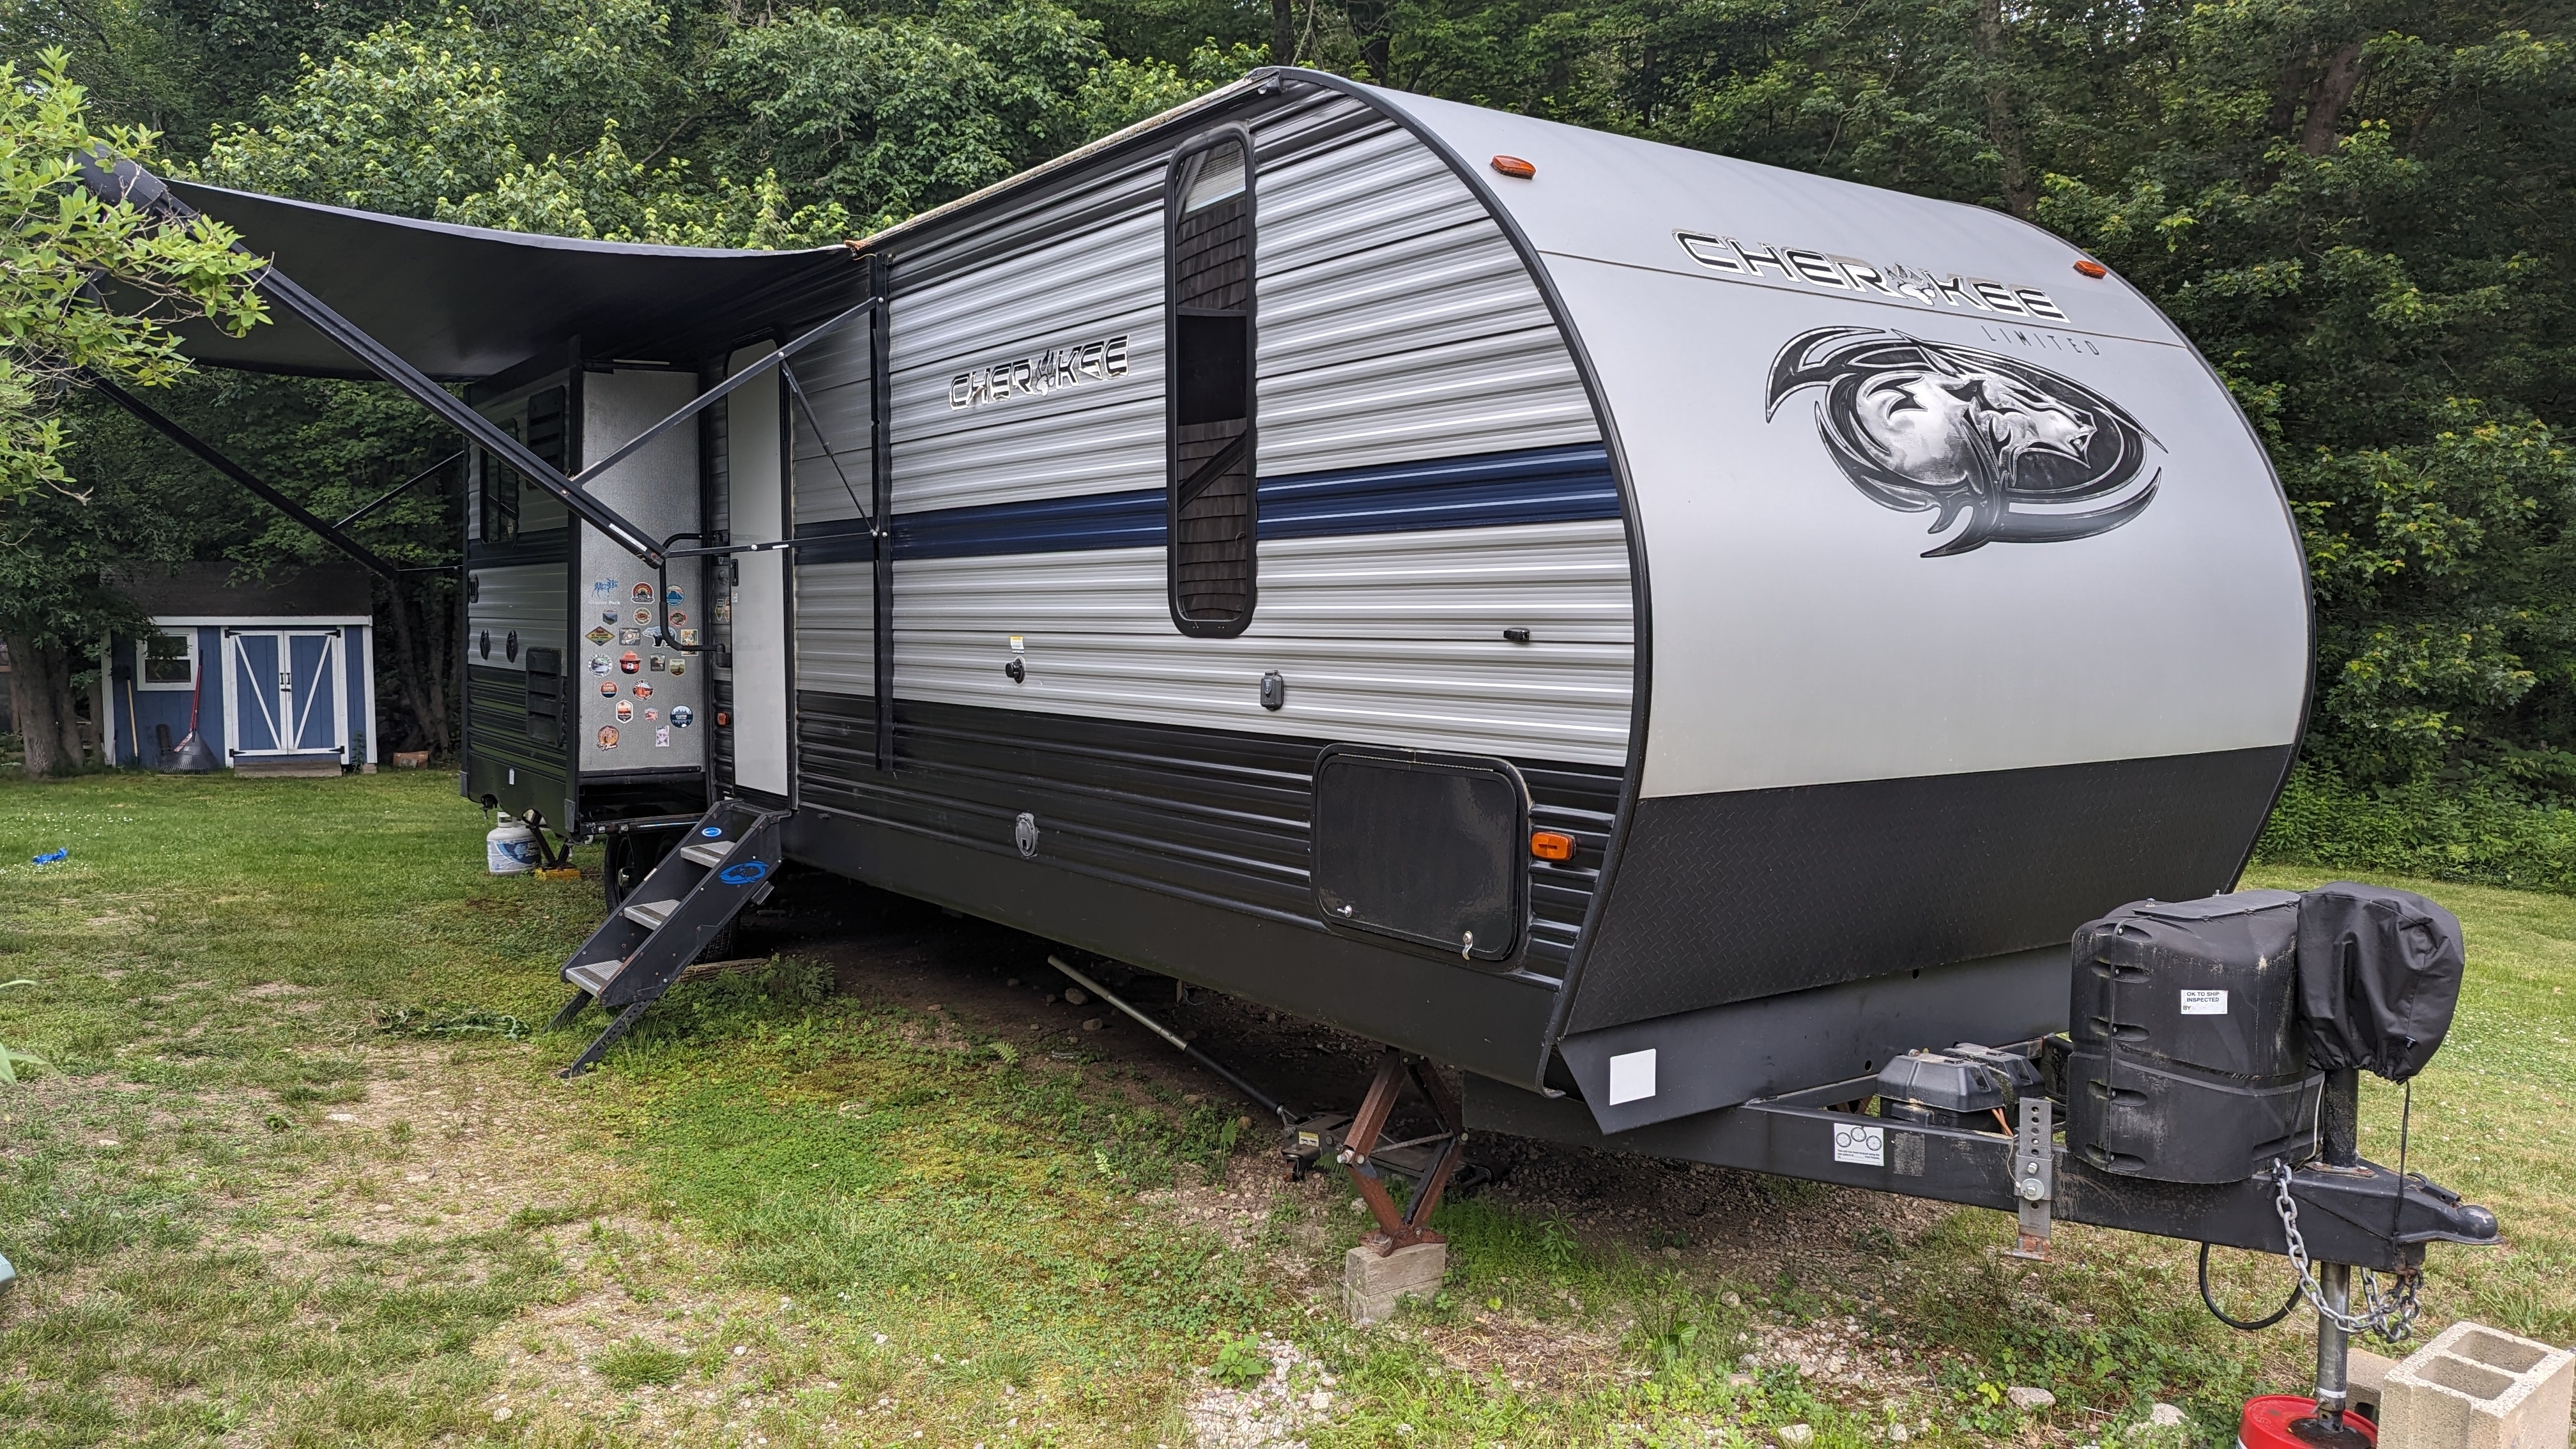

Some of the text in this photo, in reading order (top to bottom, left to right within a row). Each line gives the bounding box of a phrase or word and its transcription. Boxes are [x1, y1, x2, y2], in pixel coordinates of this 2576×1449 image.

[1671, 229, 2071, 323] CHERKEE
[949, 334, 1130, 411] CHERKEE
[1981, 325, 2100, 356] LIMITED
